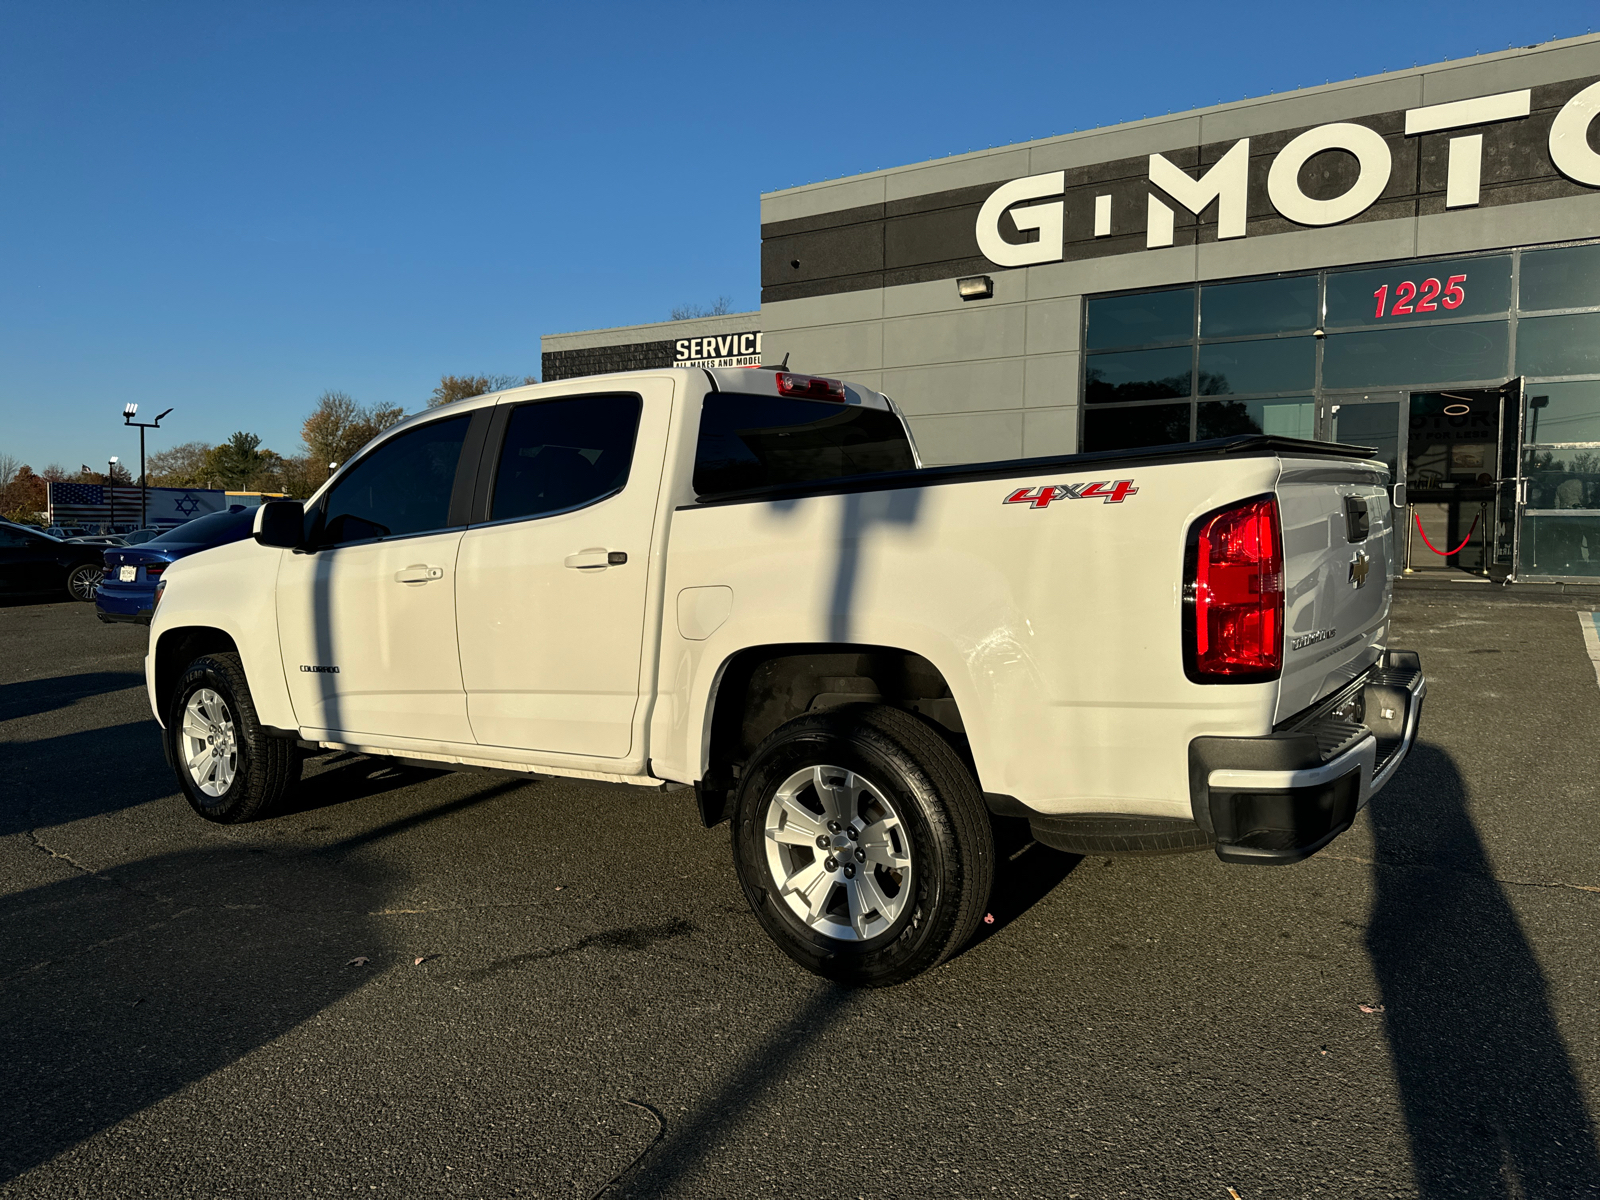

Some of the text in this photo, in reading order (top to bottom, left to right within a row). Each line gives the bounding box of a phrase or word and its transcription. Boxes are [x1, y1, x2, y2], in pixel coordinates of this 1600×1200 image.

[1373, 274, 1467, 318] 1225
[718, 358, 733, 368] AND
[1456, 430, 1489, 439] LESS
[299, 665, 340, 673] COLORADO
